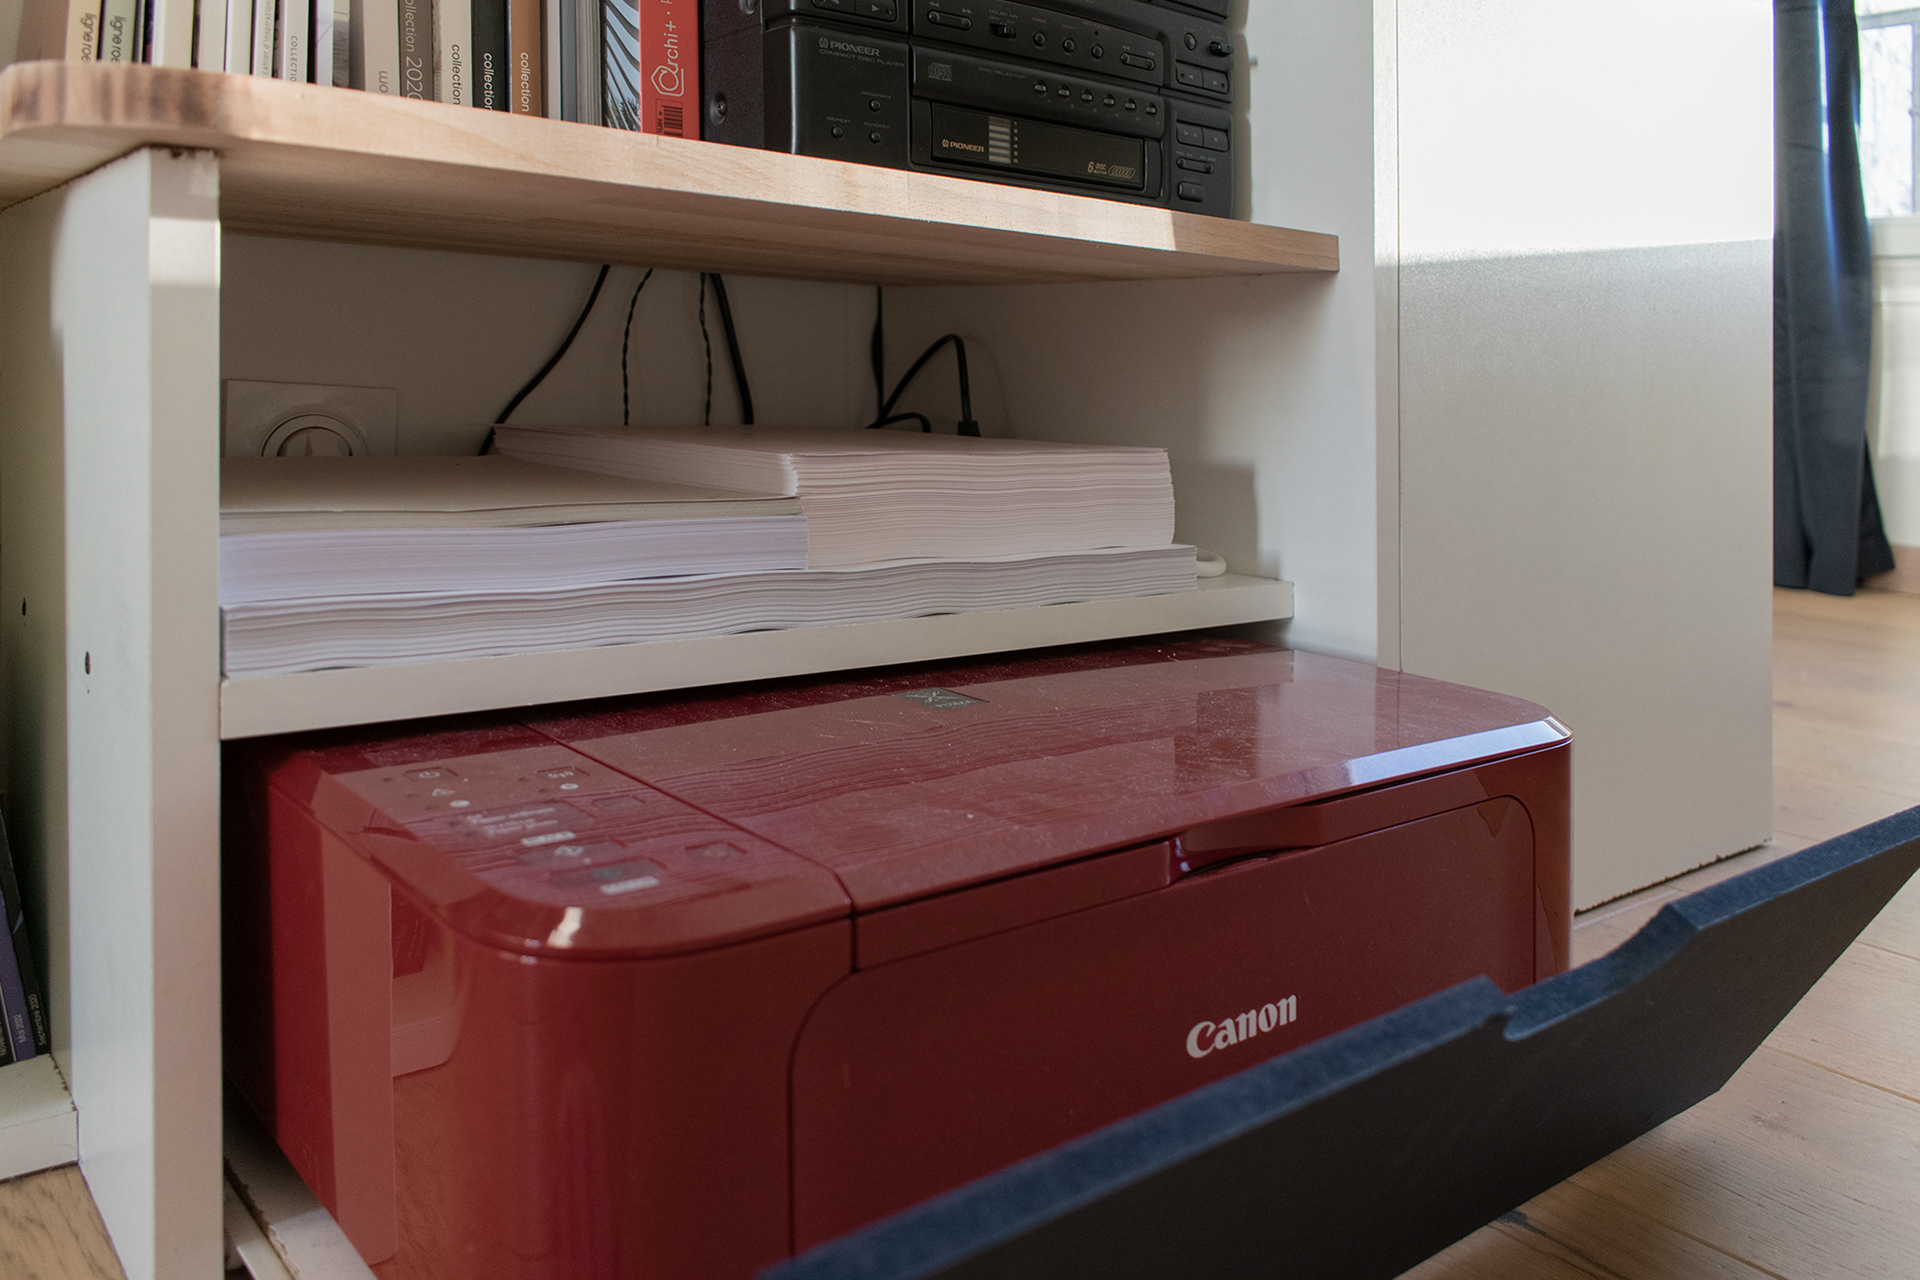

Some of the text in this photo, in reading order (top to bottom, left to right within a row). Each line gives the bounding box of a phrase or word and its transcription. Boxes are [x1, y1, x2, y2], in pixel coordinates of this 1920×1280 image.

[80, 12, 97, 42] ligne
[110, 15, 126, 44] ligne
[819, 48, 905, 68] COMPACT DISC PLAYER
[829, 40, 880, 57] PIONEER
[262, 51, 270, 75] cahier
[451, 44, 463, 105] collection
[520, 52, 531, 112] collection
[861, 91, 891, 99] PROGRAM
[826, 116, 851, 124] REPEAT
[863, 121, 890, 129] RANDOM
[950, 141, 985, 153] PIONEER
[13, 1014, 26, 1042] Mai 2022
[29, 994, 46, 1045] Septembre 2020
[1186, 994, 1297, 1058] Canon
